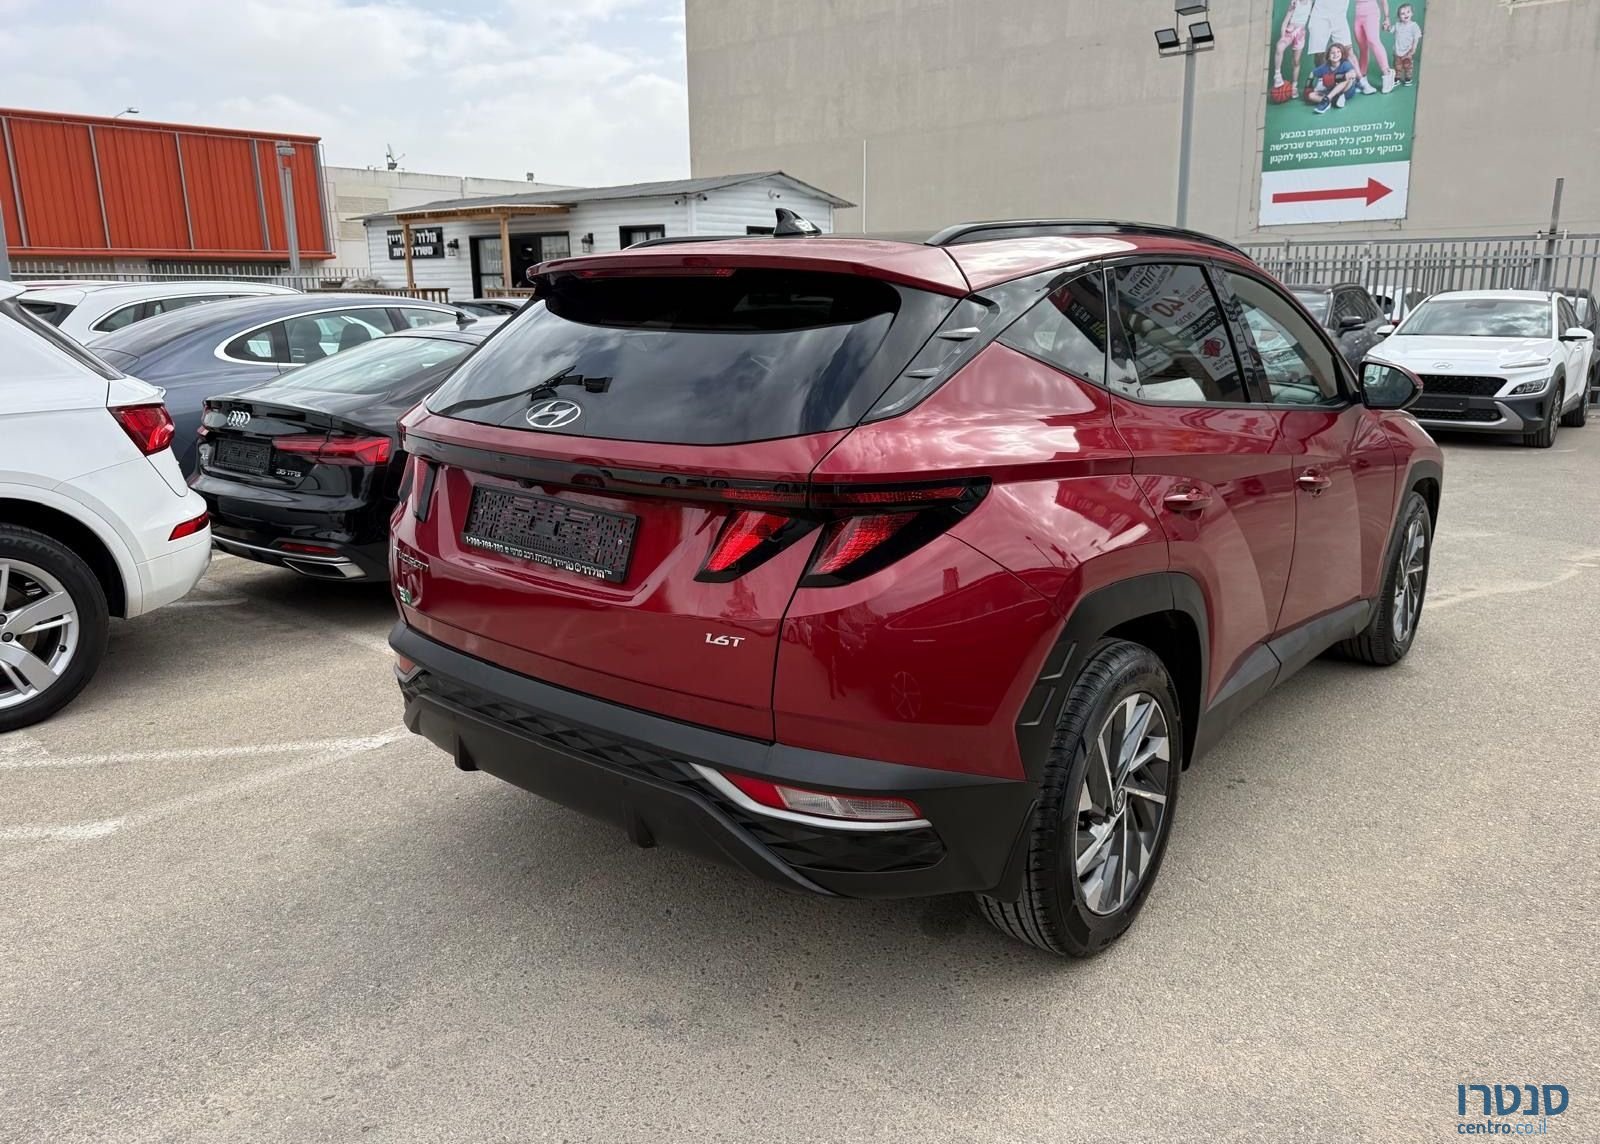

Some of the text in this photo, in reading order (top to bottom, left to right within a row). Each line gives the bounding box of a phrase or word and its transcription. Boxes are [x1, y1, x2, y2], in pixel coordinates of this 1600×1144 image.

[1279, 120, 1396, 140] על הדגמים המשתתפים במבצע
[1270, 131, 1406, 152] על הזול מבין כלל המוצרים שברכישה
[1364, 147, 1375, 155] עד
[1377, 144, 1403, 155] בתוקף
[1270, 155, 1294, 165] לתקנון
[1296, 152, 1318, 162] בכפוף
